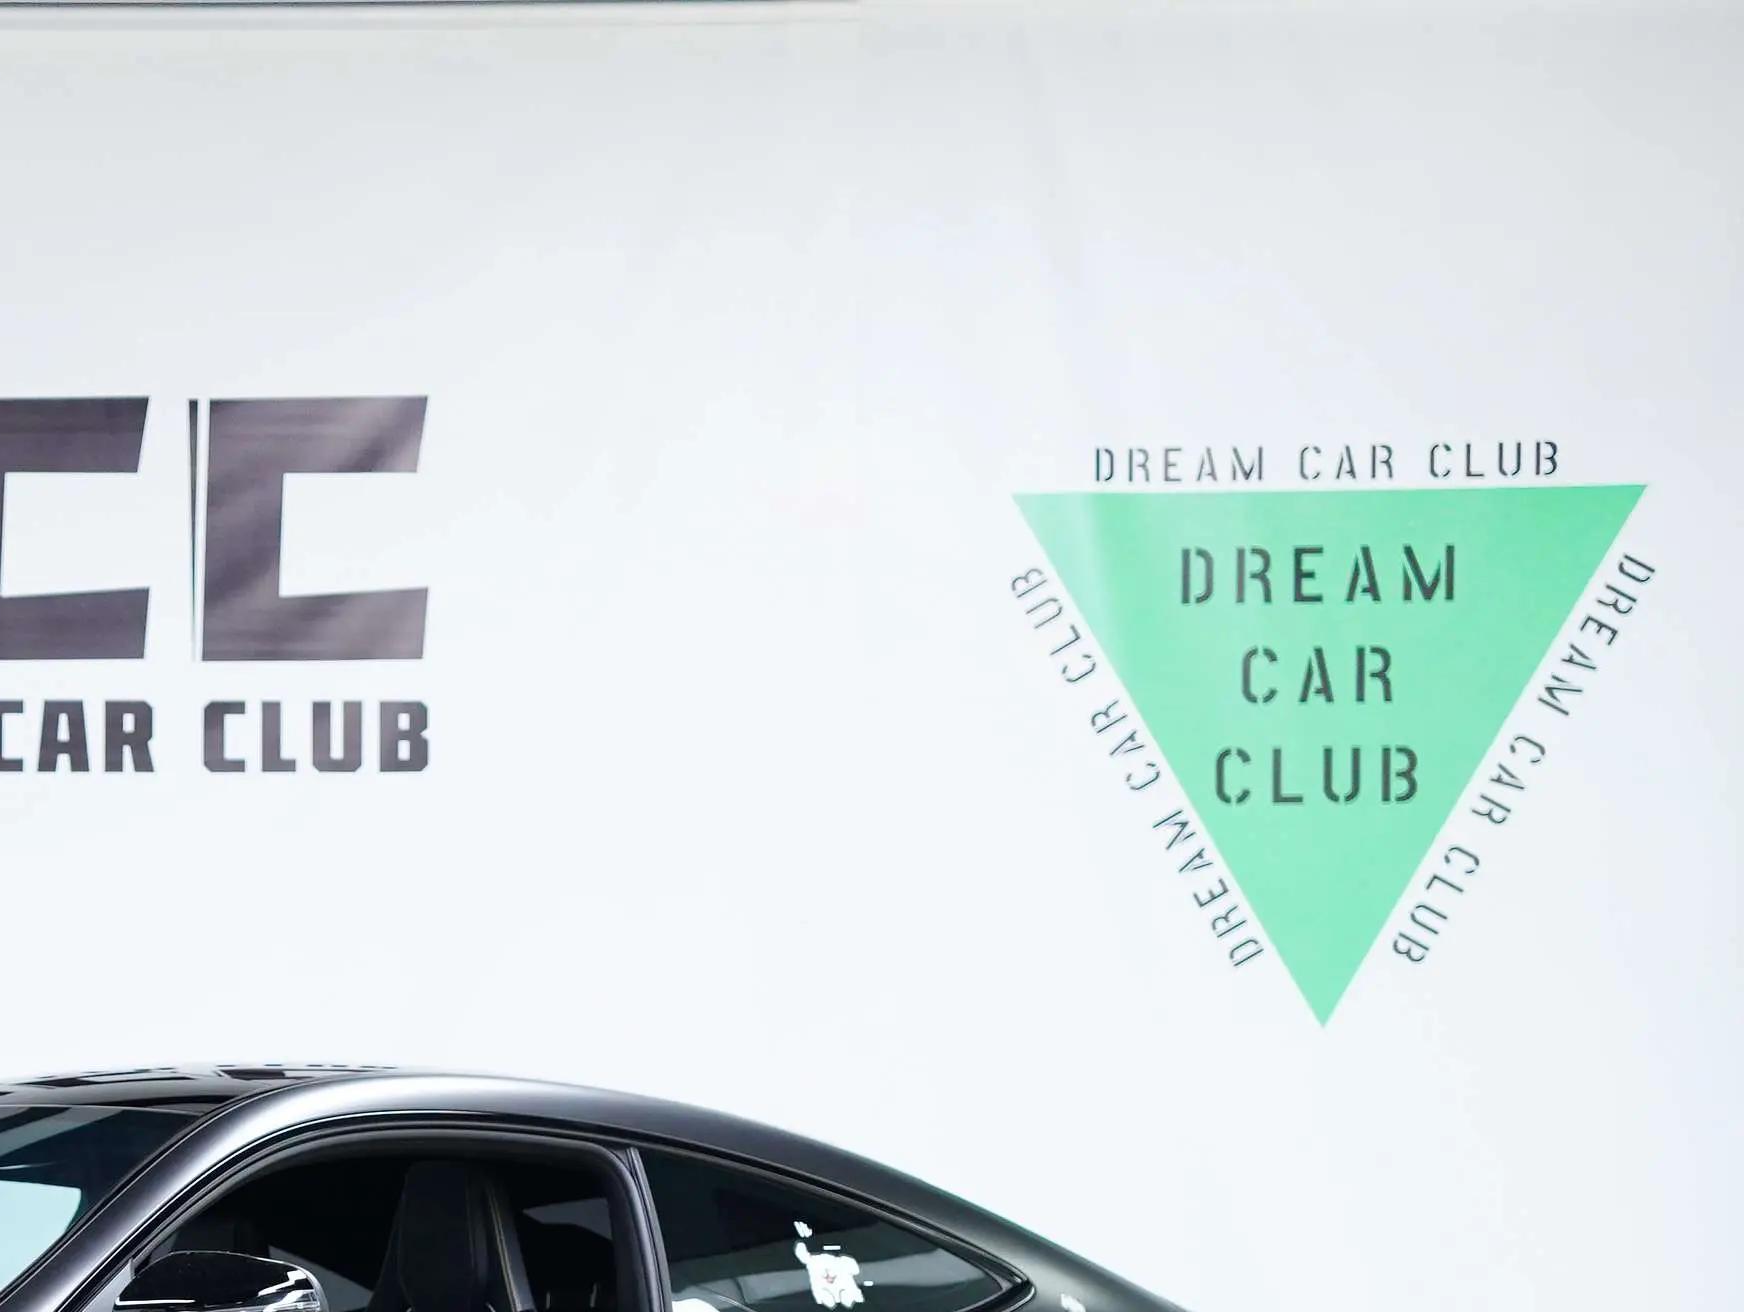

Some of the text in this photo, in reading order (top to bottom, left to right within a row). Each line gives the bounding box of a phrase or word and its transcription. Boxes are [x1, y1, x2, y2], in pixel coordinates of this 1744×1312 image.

[1095, 440, 1559, 483] DREAM CAR CLUB
[1180, 543, 1456, 606] DREAM
[1241, 645, 1393, 705] CAR
[203, 700, 429, 773] CLUB
[1011, 567, 1264, 967] DREAM CAR CLUB
[1392, 553, 1656, 963] DREAM CAR CLUB
[1215, 744, 1418, 806] CLUB
